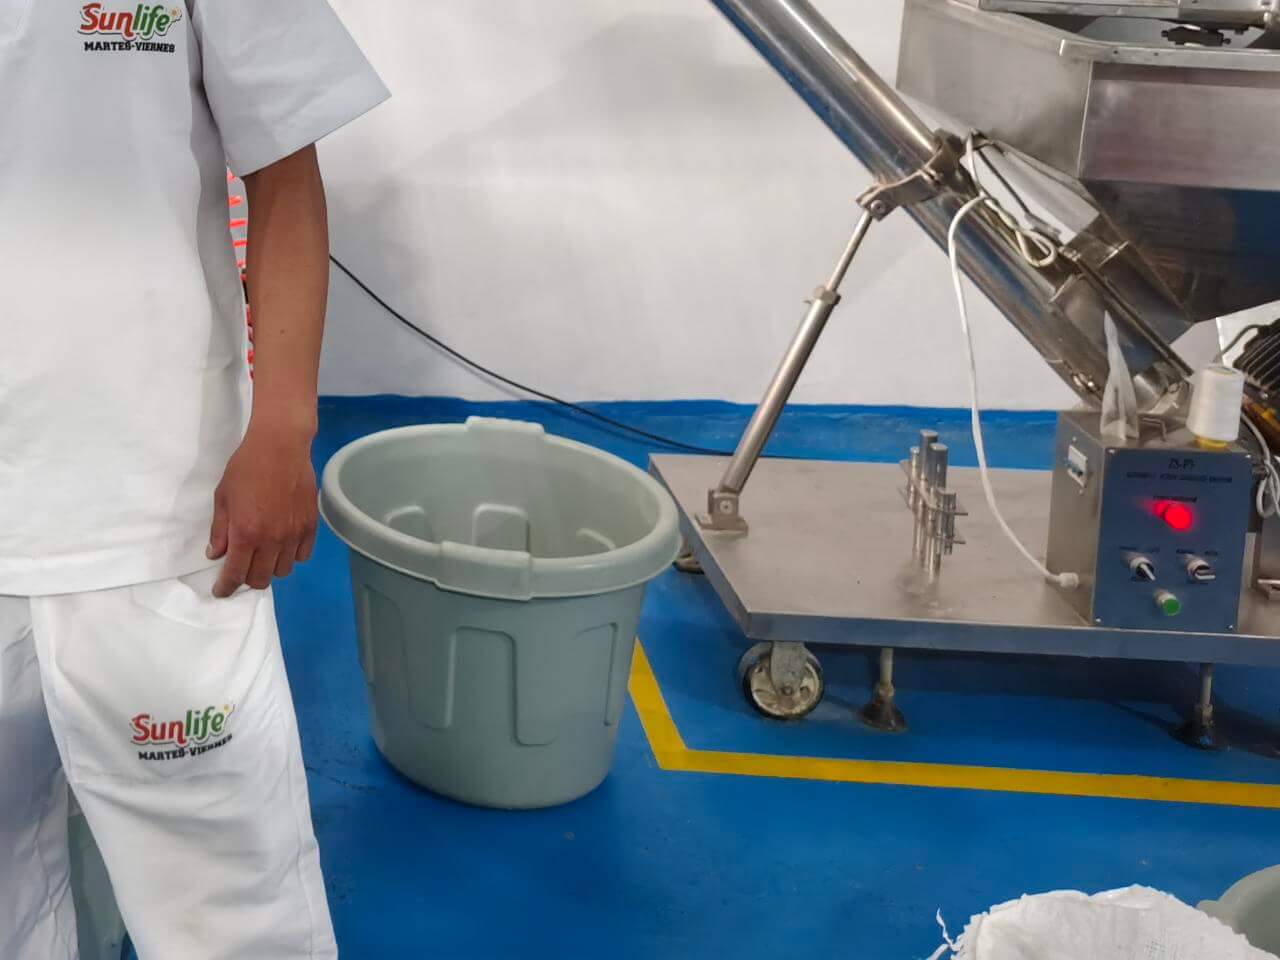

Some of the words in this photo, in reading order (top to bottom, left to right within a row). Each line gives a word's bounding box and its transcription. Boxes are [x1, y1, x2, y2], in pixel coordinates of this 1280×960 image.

[80, 2, 171, 38] Sunlife
[84, 40, 176, 53] MARTES-VIERNES
[132, 705, 225, 745] Sunlife
[138, 732, 233, 761] MARTES-VIERNES
